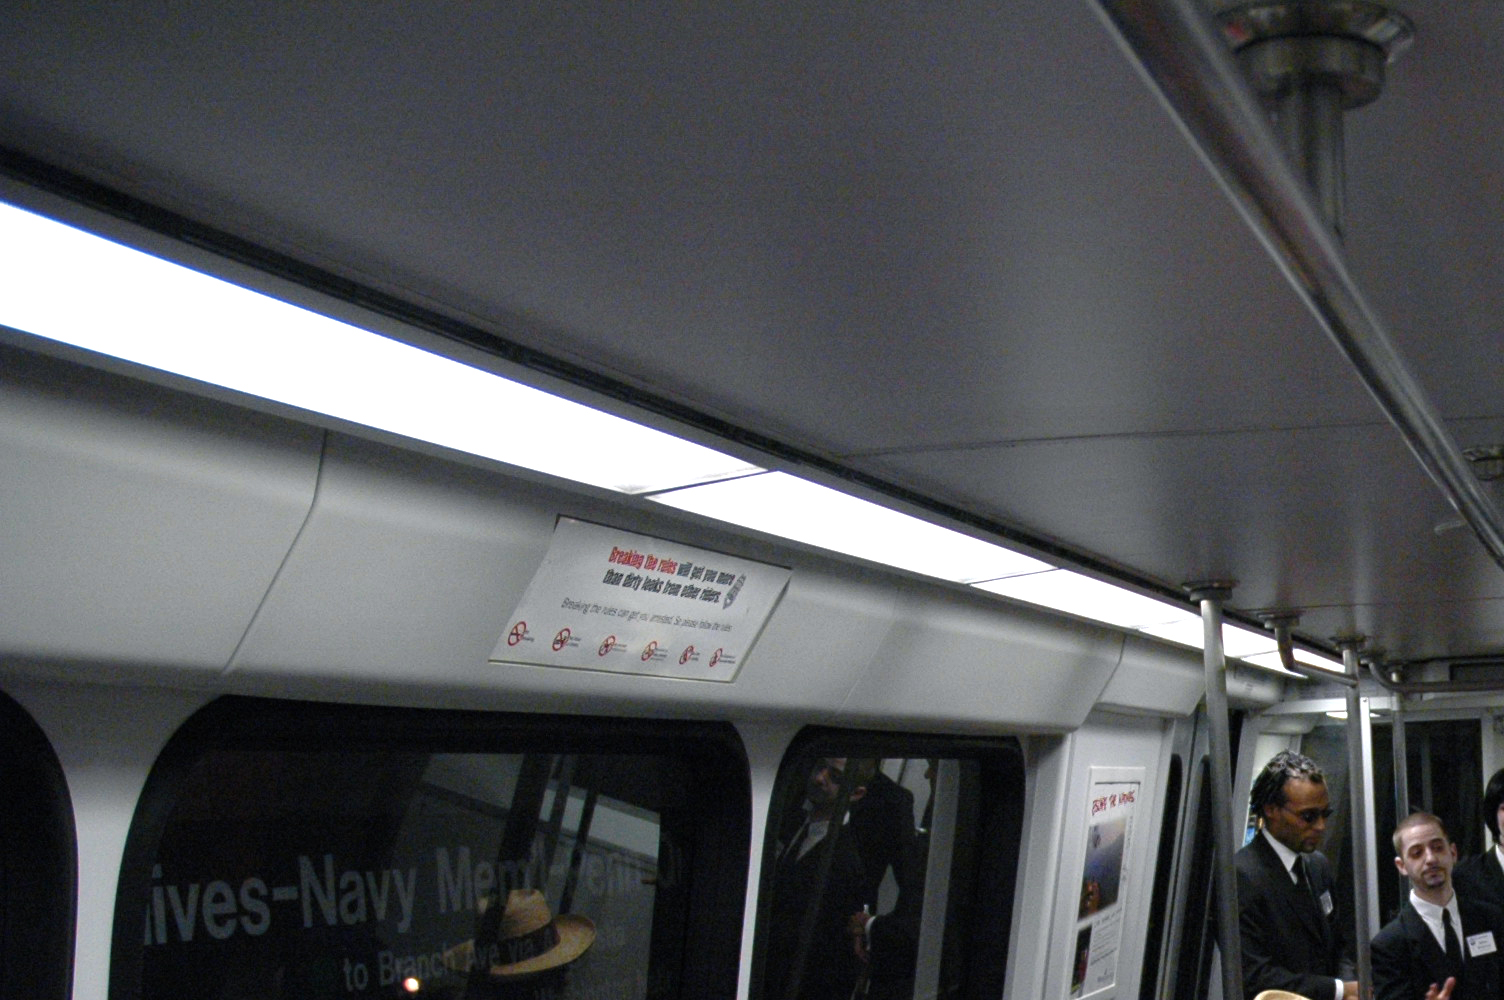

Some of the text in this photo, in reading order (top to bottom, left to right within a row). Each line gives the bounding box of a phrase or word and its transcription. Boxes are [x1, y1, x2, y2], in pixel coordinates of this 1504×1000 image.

[608, 546, 644, 569] Breaking
[644, 553, 658, 569] the
[659, 557, 677, 574] rules
[602, 569, 623, 586] than
[623, 571, 641, 590] dirty
[643, 576, 663, 593] looks
[561, 597, 590, 614] Breaking
[144, 853, 417, 945] ives-Navy
[343, 956, 369, 992] to
[378, 942, 455, 988] Branch
